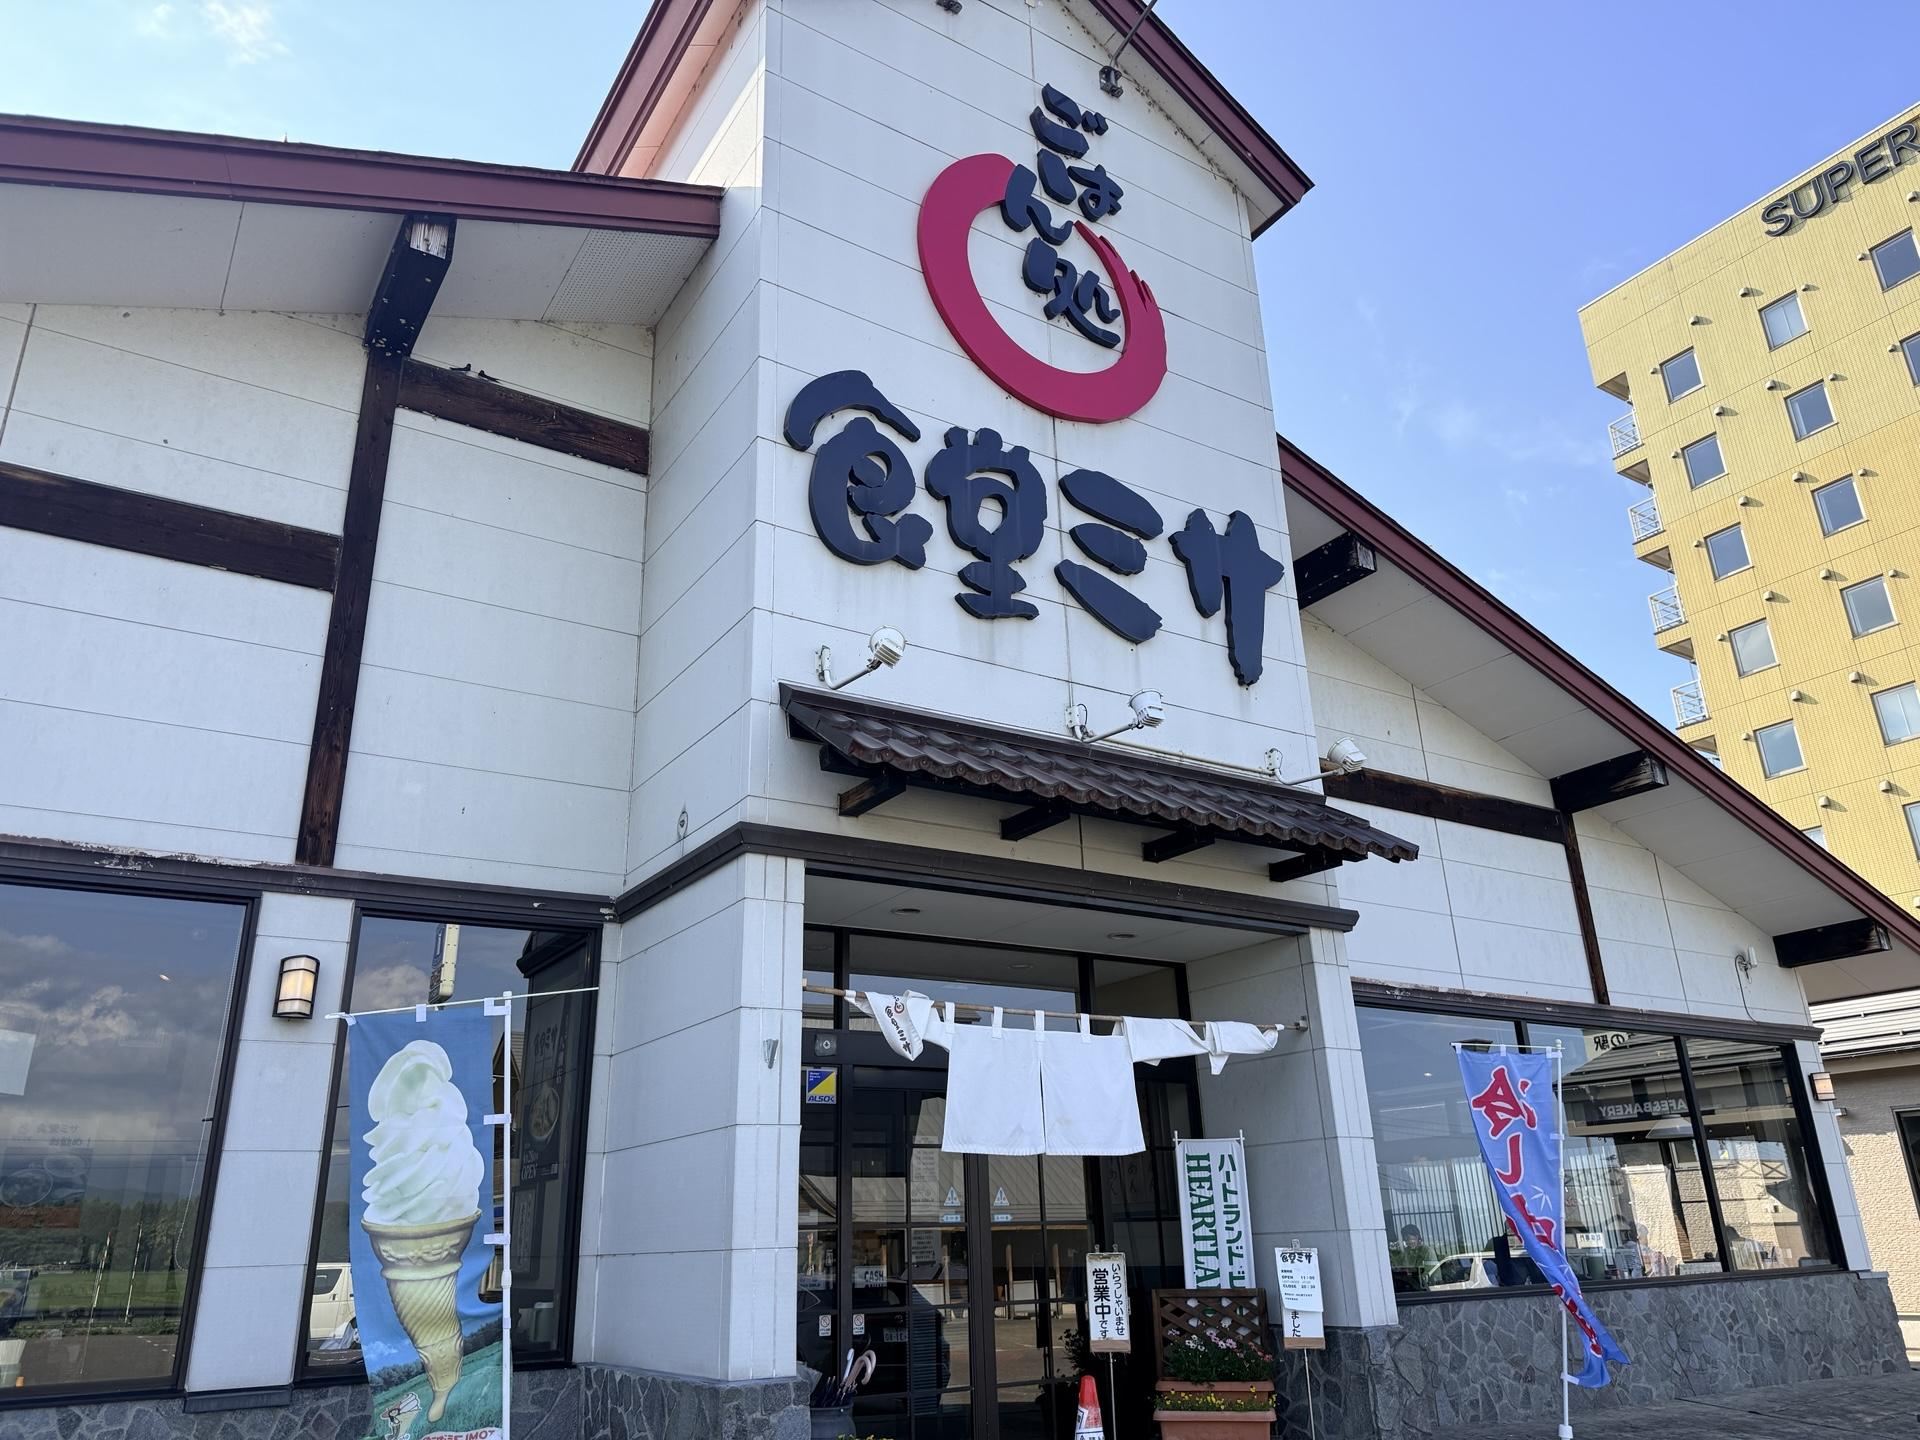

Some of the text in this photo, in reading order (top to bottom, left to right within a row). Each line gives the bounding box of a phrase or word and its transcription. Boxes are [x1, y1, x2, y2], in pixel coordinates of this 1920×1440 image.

[1000, 83, 1123, 349] ごはん処
[1761, 122, 1920, 237] SUPER
[783, 369, 1285, 686] 食堂ミサ
[1185, 1152, 1221, 1289] HEARTLA
[1218, 1153, 1246, 1289] ハートランドビ
[1092, 1268, 1111, 1339] 営業中です
[1111, 1263, 1125, 1336] いらっしゃいませ
[1291, 1311, 1302, 1338] ました
